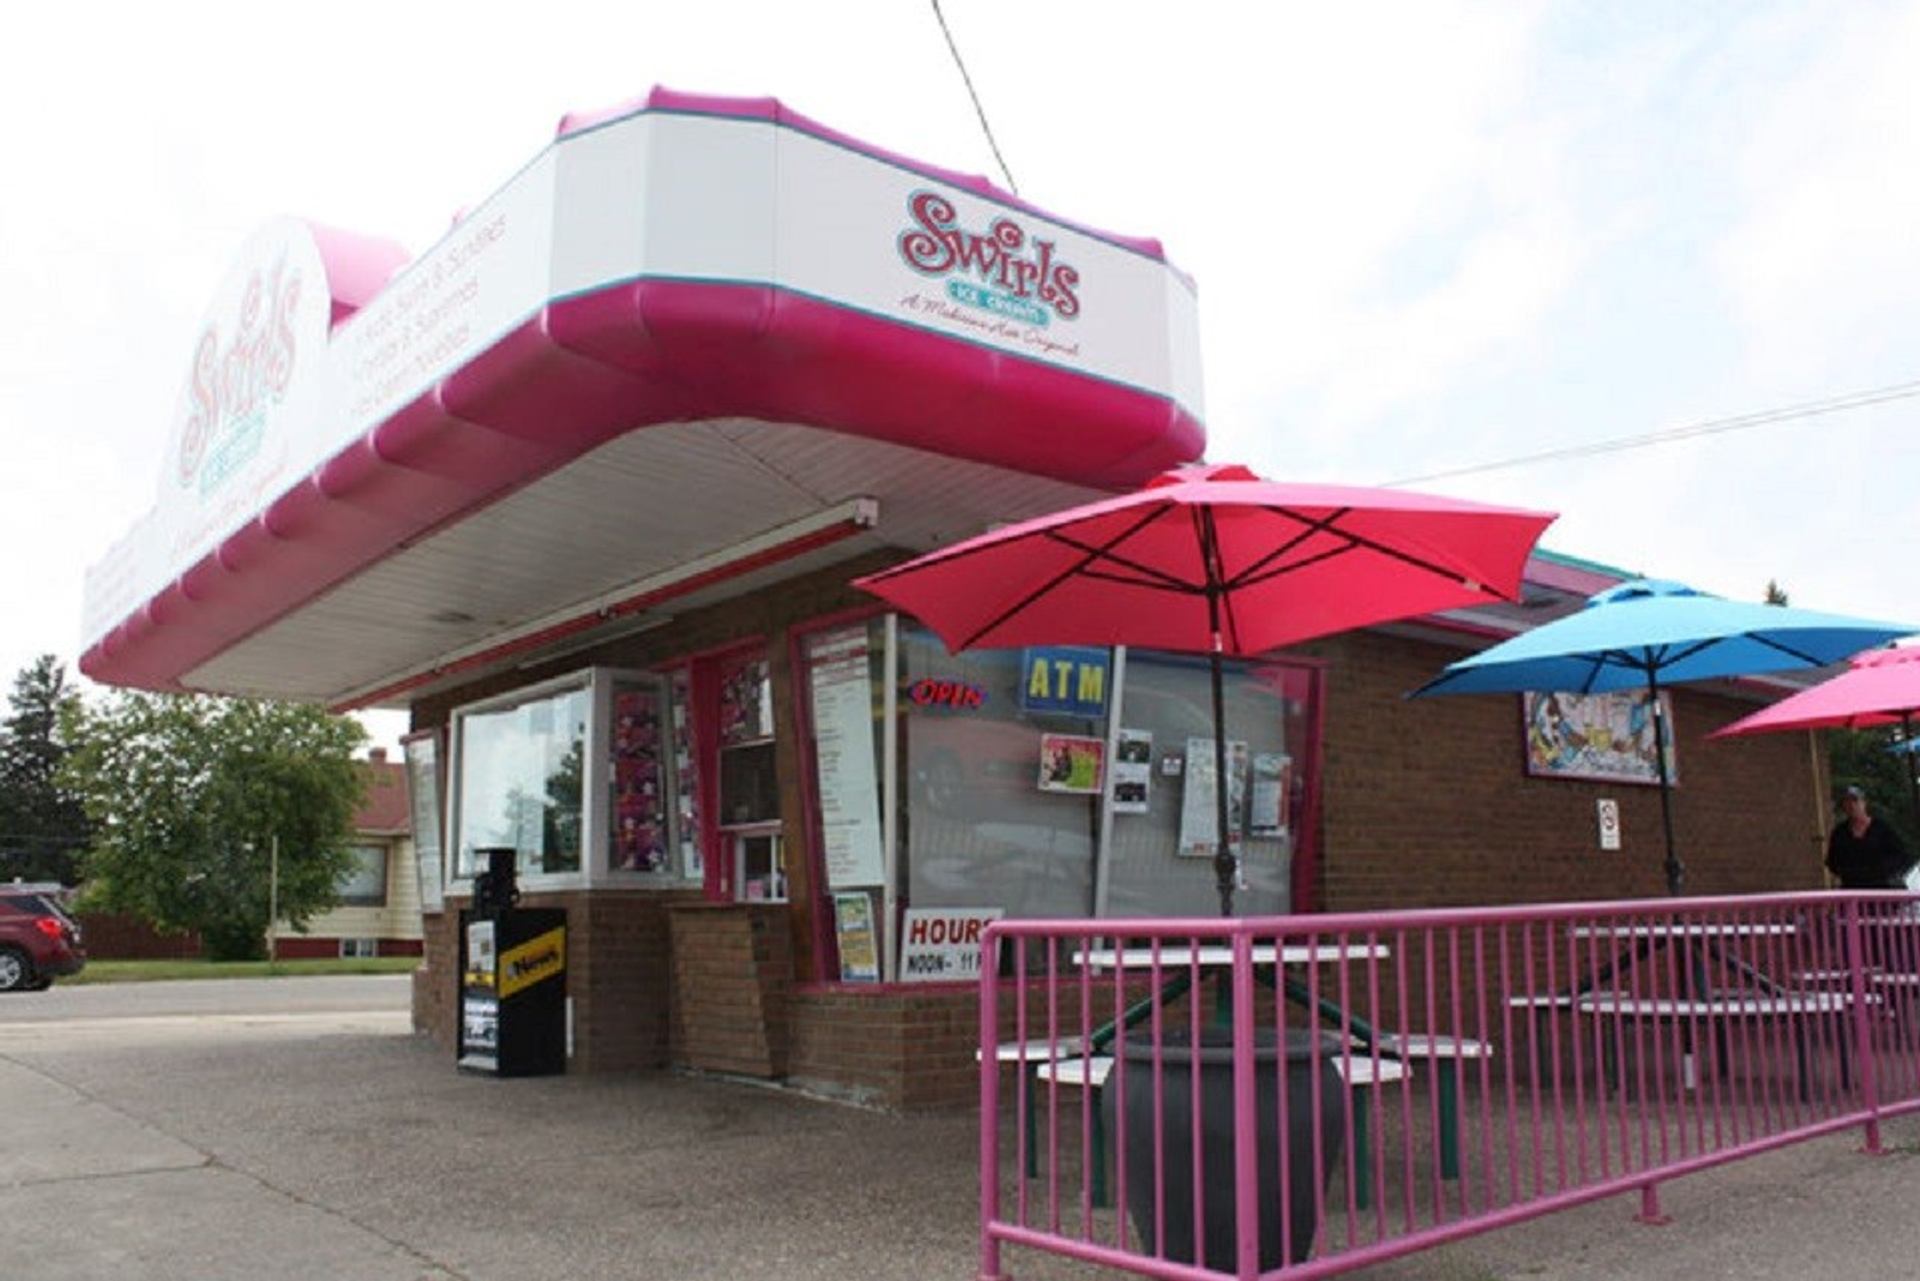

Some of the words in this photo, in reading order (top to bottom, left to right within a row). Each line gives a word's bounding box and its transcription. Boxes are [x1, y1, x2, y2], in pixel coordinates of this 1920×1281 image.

[898, 190, 1081, 319] Swirls
[911, 677, 983, 707] OPEN
[1029, 657, 1104, 703] ATM
[909, 919, 994, 945] HOUR
